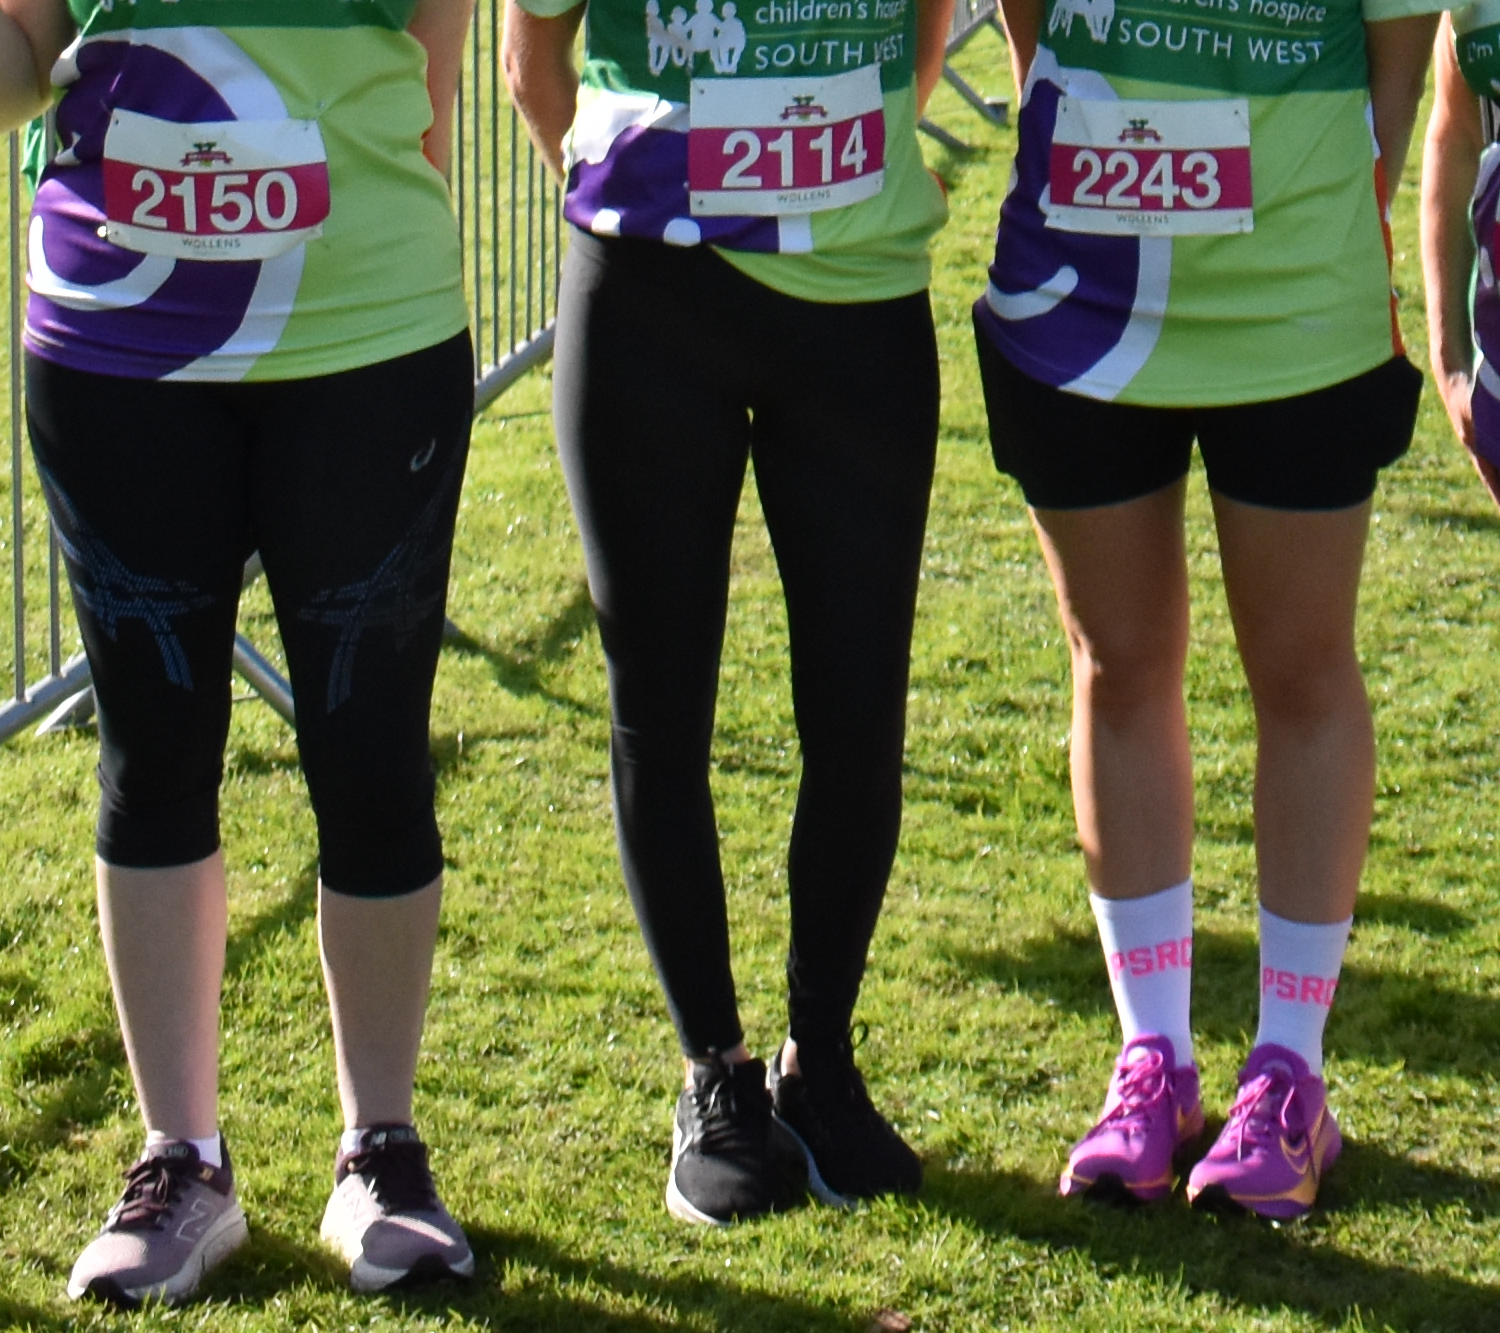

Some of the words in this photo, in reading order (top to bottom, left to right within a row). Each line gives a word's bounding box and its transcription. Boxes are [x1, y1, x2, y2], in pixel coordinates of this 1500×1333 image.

[754, 40, 863, 71] SOUTH
[1117, 18, 1233, 59] SOUTH
[1248, 38, 1324, 65] WEST
[1466, 40, 1494, 63] I'm
[721, 118, 868, 189] 2114
[776, 189, 832, 203] WOLLENS
[1072, 148, 1222, 209] 2243
[130, 169, 299, 233] 2150
[181, 237, 242, 249] WOLLENS
